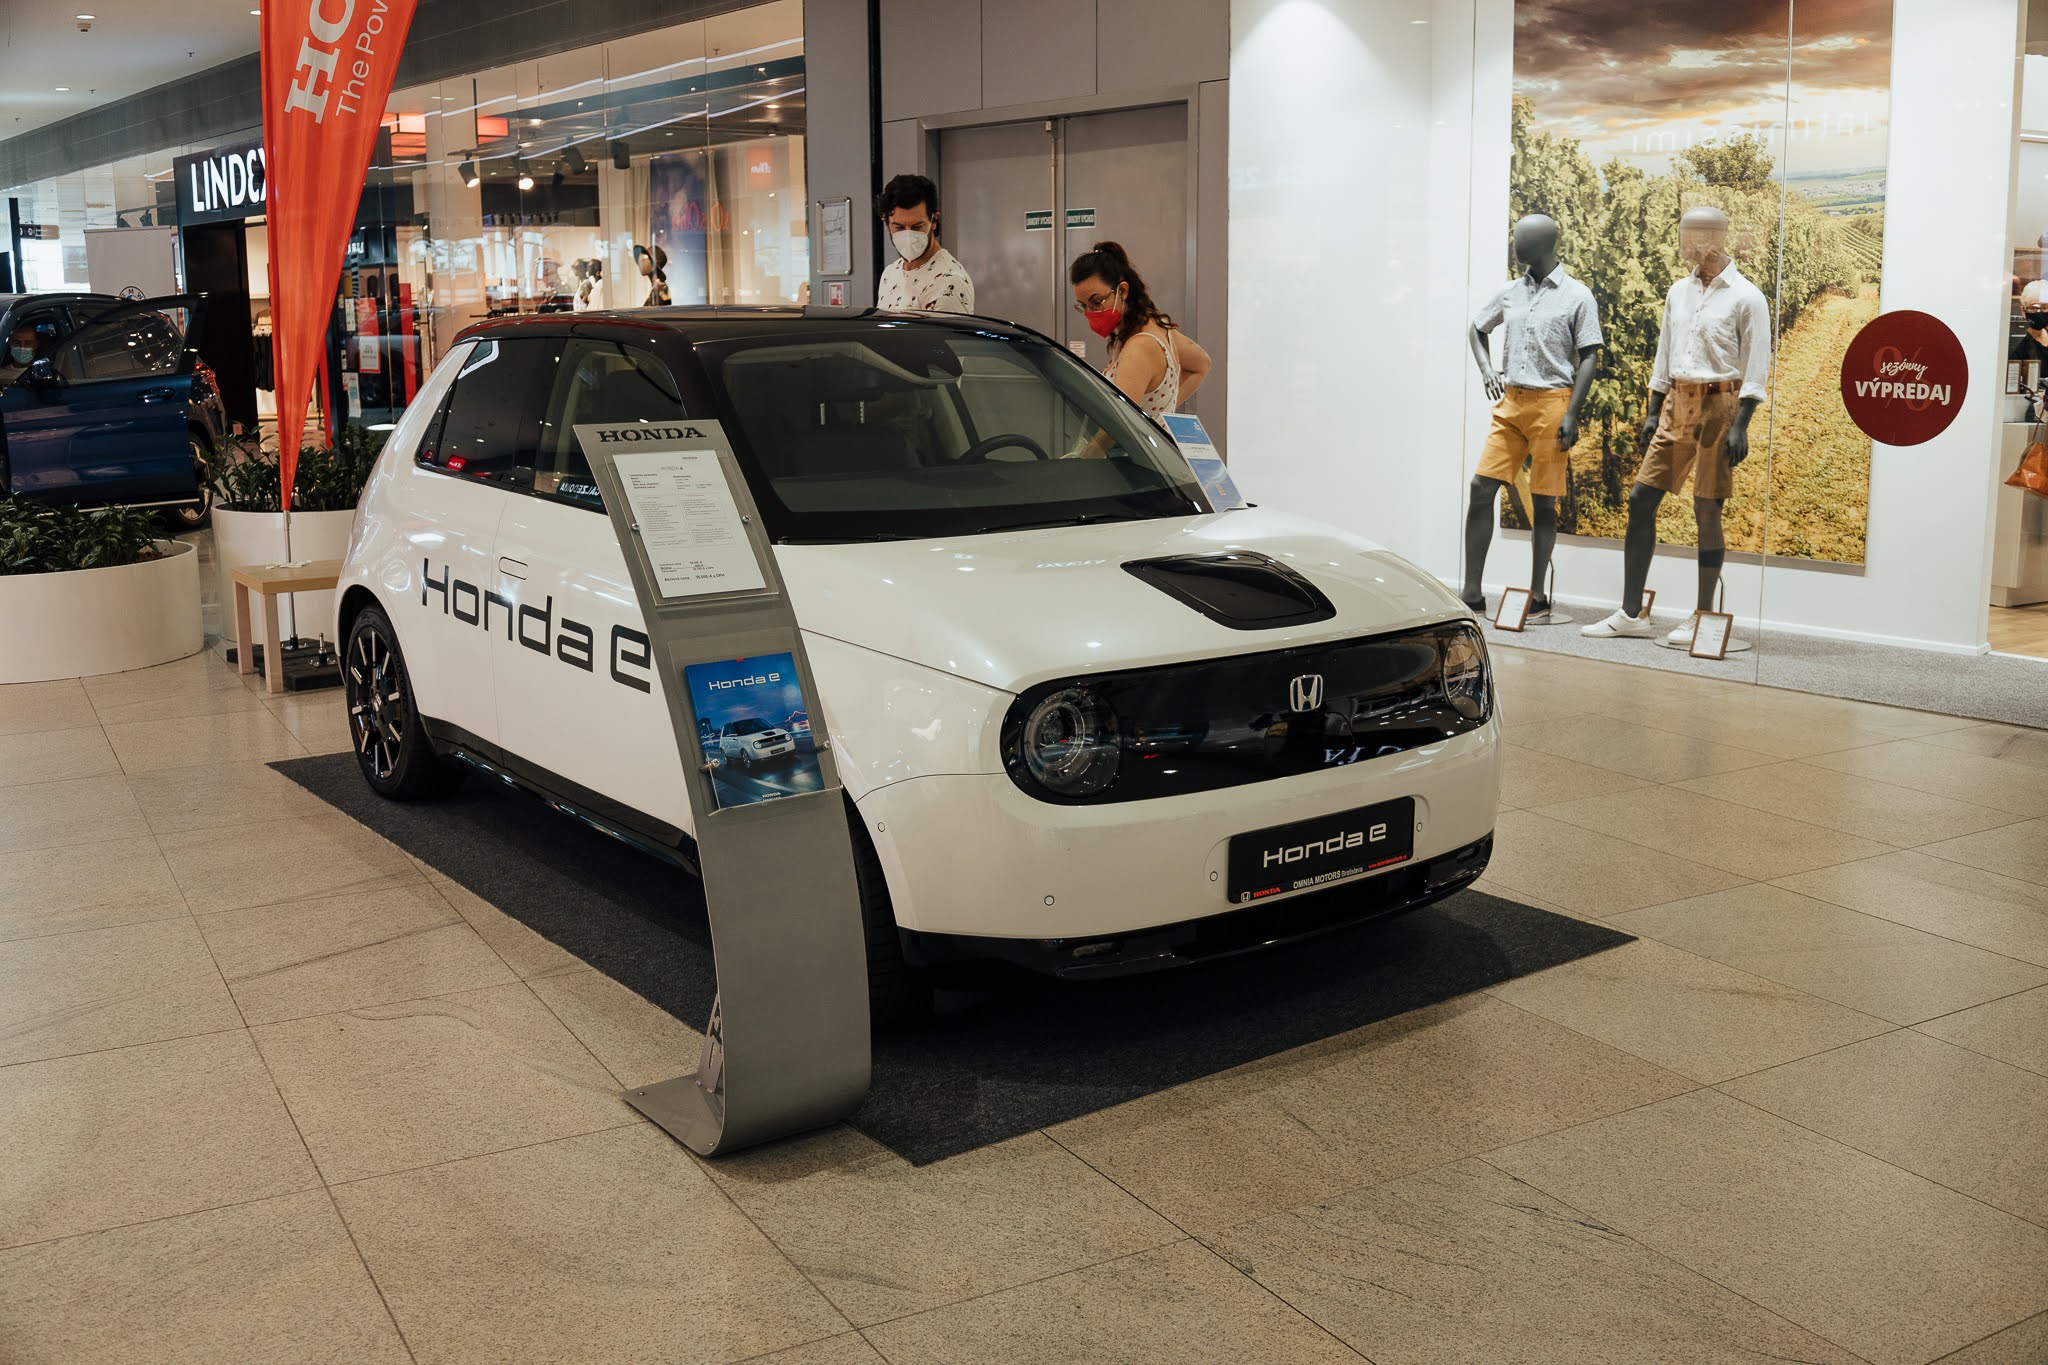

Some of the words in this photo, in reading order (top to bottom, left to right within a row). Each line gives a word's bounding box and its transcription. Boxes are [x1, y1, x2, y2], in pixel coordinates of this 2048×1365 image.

[336, 60, 369, 116] The
[1880, 359, 1928, 380] sezónny
[1855, 377, 1951, 406] VÝPREDAJ
[596, 427, 707, 442] HONDA
[422, 558, 593, 673] Honda
[610, 624, 651, 694] e
[708, 676, 766, 690] Honda
[768, 672, 781, 682] e
[1263, 831, 1363, 868] Honda
[1369, 823, 1386, 842] e
[1293, 877, 1314, 889] OMNIA
[1314, 870, 1341, 885] MOTORS
[1341, 867, 1364, 877] Bratislava
[1253, 887, 1280, 898] HONDA
